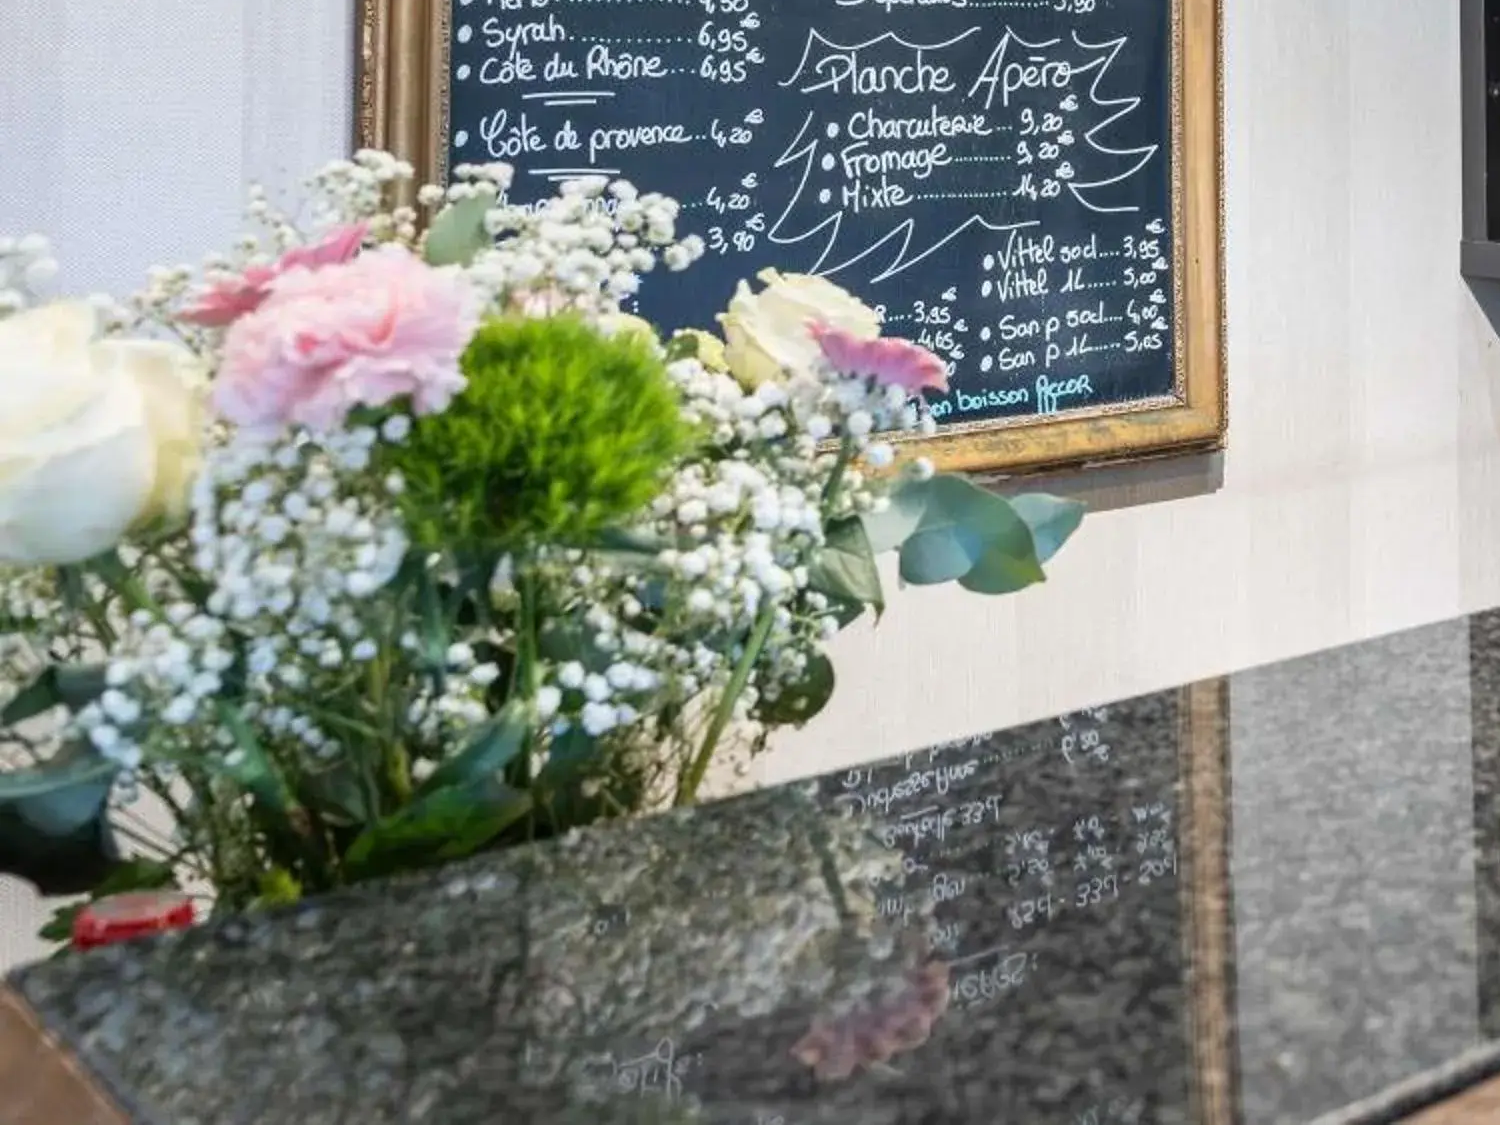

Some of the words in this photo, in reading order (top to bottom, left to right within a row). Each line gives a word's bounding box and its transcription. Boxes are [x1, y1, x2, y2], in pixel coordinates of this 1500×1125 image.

[482, 13, 567, 61] Syrah
[699, 12, 761, 51] 6,95€
[543, 56, 579, 80] du
[699, 47, 765, 83] 6,95€
[801, 49, 956, 95] Planche
[1019, 94, 1079, 135] 9,20€
[555, 121, 583, 151] de
[590, 126, 693, 164] provence
[709, 109, 765, 147] 4,20€
[841, 141, 952, 179] Fromage
[1016, 130, 1075, 165] 9,20€
[706, 172, 758, 214] 4,20€
[708, 212, 765, 255] 3,90€
[998, 228, 1056, 273] Vittel
[1059, 235, 1098, 265] 50cl
[1121, 218, 1166, 263] 3,95€
[997, 269, 1050, 303] Vittel
[999, 315, 1040, 340] San
[1066, 301, 1104, 325] 50cl
[998, 349, 1036, 371] San
[957, 386, 1029, 412] boisson
